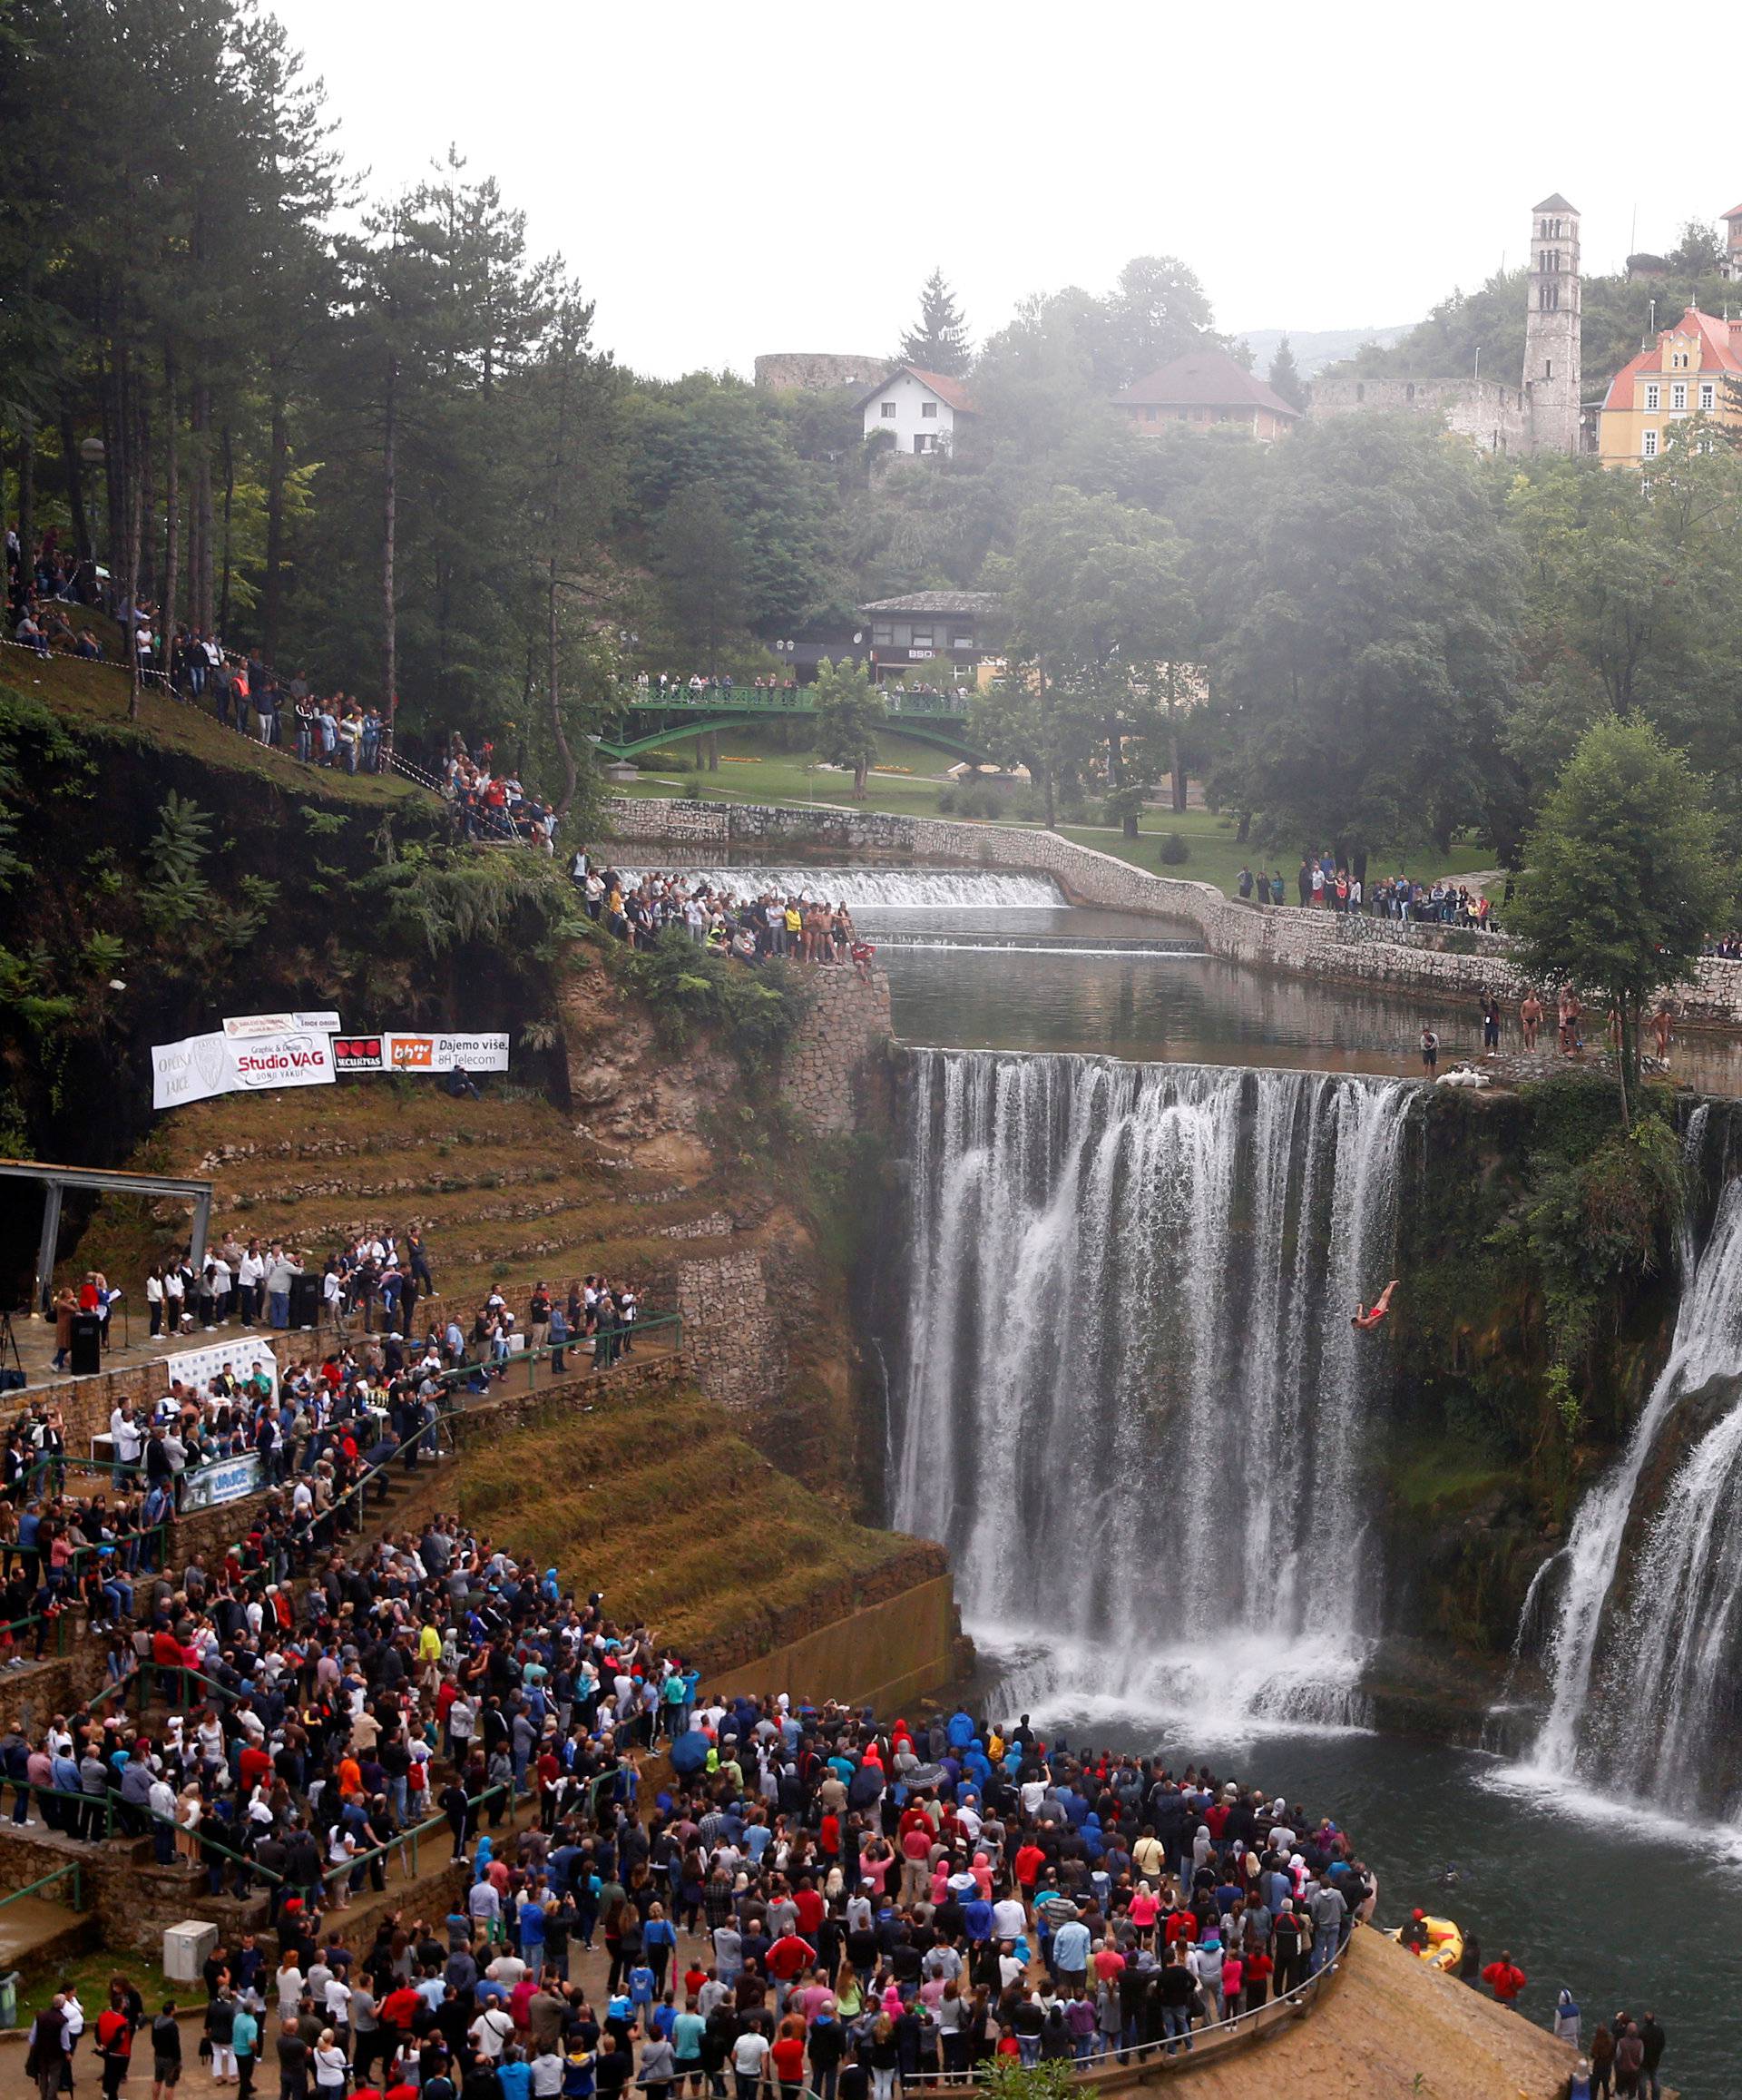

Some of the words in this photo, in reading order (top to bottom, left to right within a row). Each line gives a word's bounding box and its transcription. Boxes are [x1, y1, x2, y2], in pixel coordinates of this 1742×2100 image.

[251, 1045, 273, 1054] Graphic
[282, 1043, 302, 1053] Design
[439, 1039, 479, 1053] Dajemo
[482, 1039, 508, 1050] više.
[238, 1055, 289, 1072] Studio
[290, 1051, 324, 1067] VAG
[338, 1057, 381, 1067] SECURITAS
[438, 1055, 452, 1065] BH
[454, 1054, 495, 1065] Telecom
[280, 1069, 304, 1078] VAKUF
